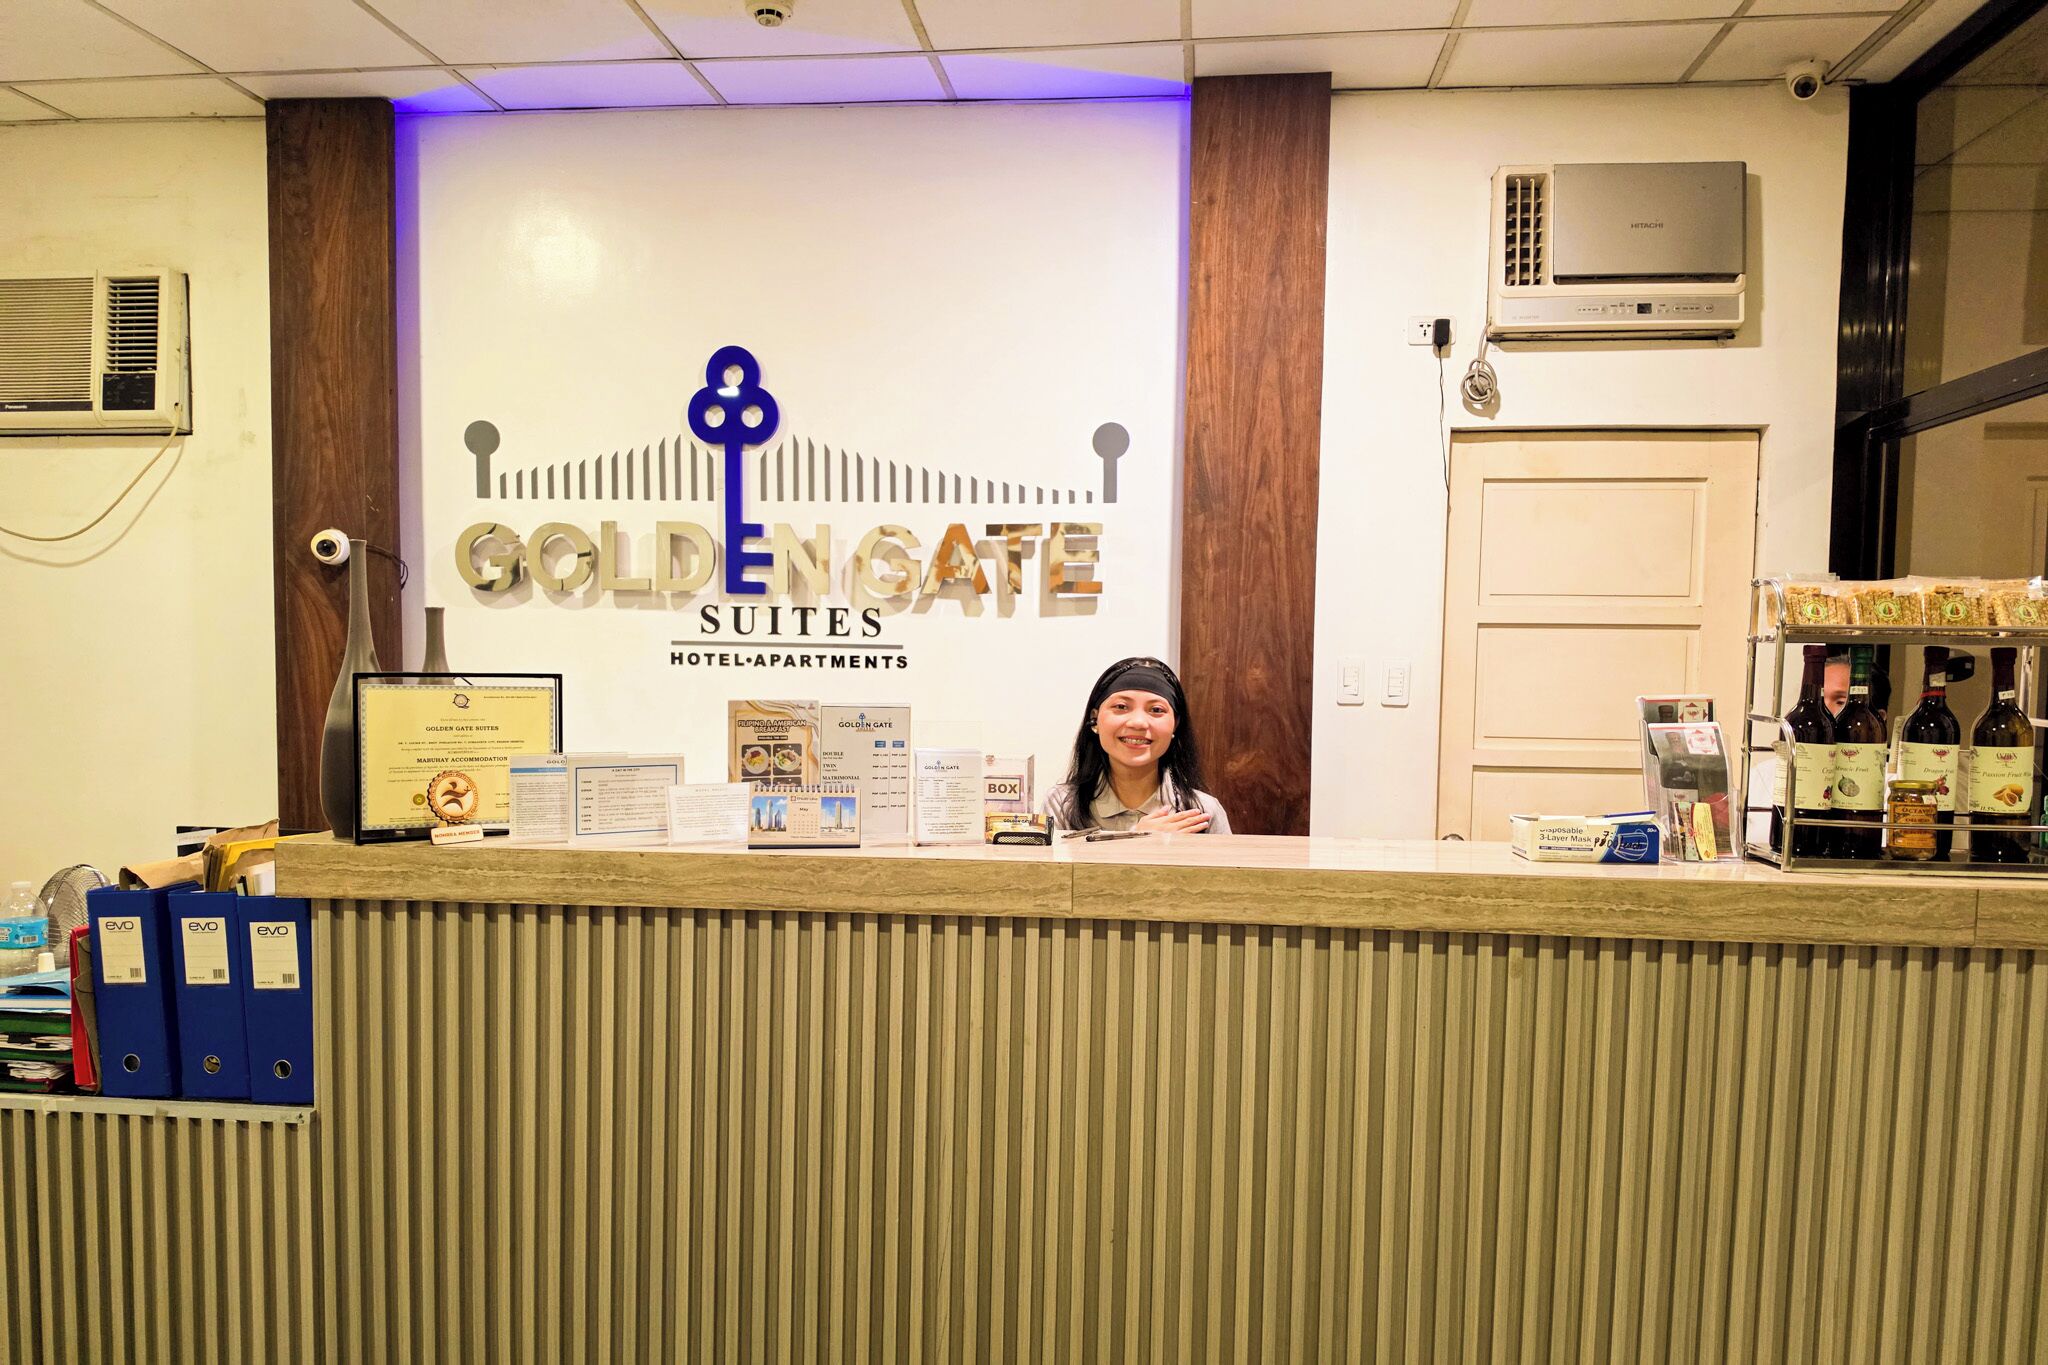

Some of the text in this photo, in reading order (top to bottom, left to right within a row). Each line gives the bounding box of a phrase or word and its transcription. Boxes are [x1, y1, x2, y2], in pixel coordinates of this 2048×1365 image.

[455, 519, 1103, 595] GOLDEN GATE
[700, 604, 882, 638] SUITES
[737, 719, 765, 727] FILIPINO
[774, 719, 807, 727] AMERICAN
[987, 783, 1018, 794] BOX
[1539, 833, 1592, 843] 3-Layer Mask
[105, 920, 134, 931] evo
[188, 921, 219, 931] evo
[257, 925, 289, 936] evo
